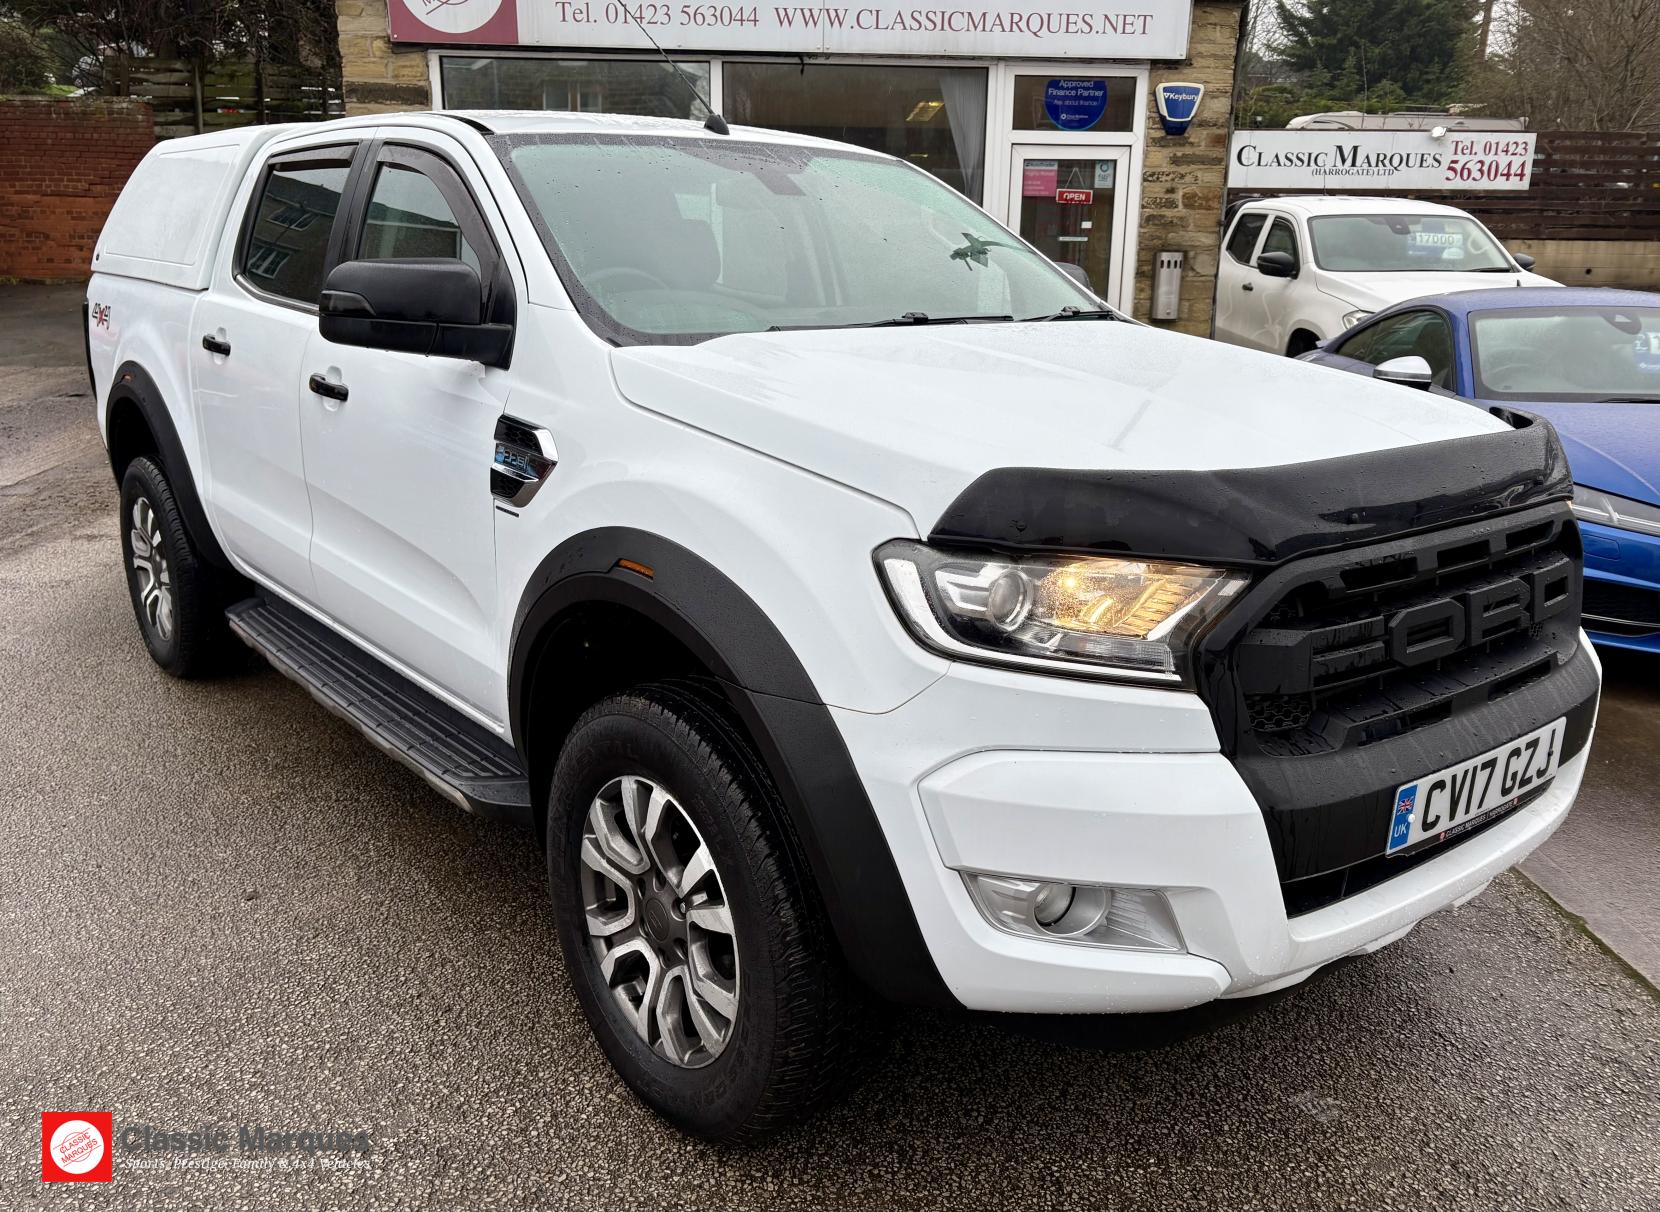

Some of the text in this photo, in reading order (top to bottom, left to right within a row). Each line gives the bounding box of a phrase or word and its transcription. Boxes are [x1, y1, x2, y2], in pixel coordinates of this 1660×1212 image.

[555, 1, 1154, 38] Tel. 01423 563044 WWW.CLASSICMARQUES.NET
[1048, 88, 1105, 97] Finance Partner
[1059, 79, 1094, 89] Approved
[1169, 92, 1199, 102] Keybury
[1450, 140, 1529, 157] Tel. 01423
[1236, 144, 1443, 172] CLASSIC MARQUES
[1311, 168, 1395, 177] (HARROGATE) LTD
[1444, 159, 1527, 183] 563044
[1063, 192, 1086, 201] OPEN
[1239, 557, 1576, 695] FORD
[1421, 728, 1556, 833] CV17 GZJ
[1394, 821, 1407, 838] UK
